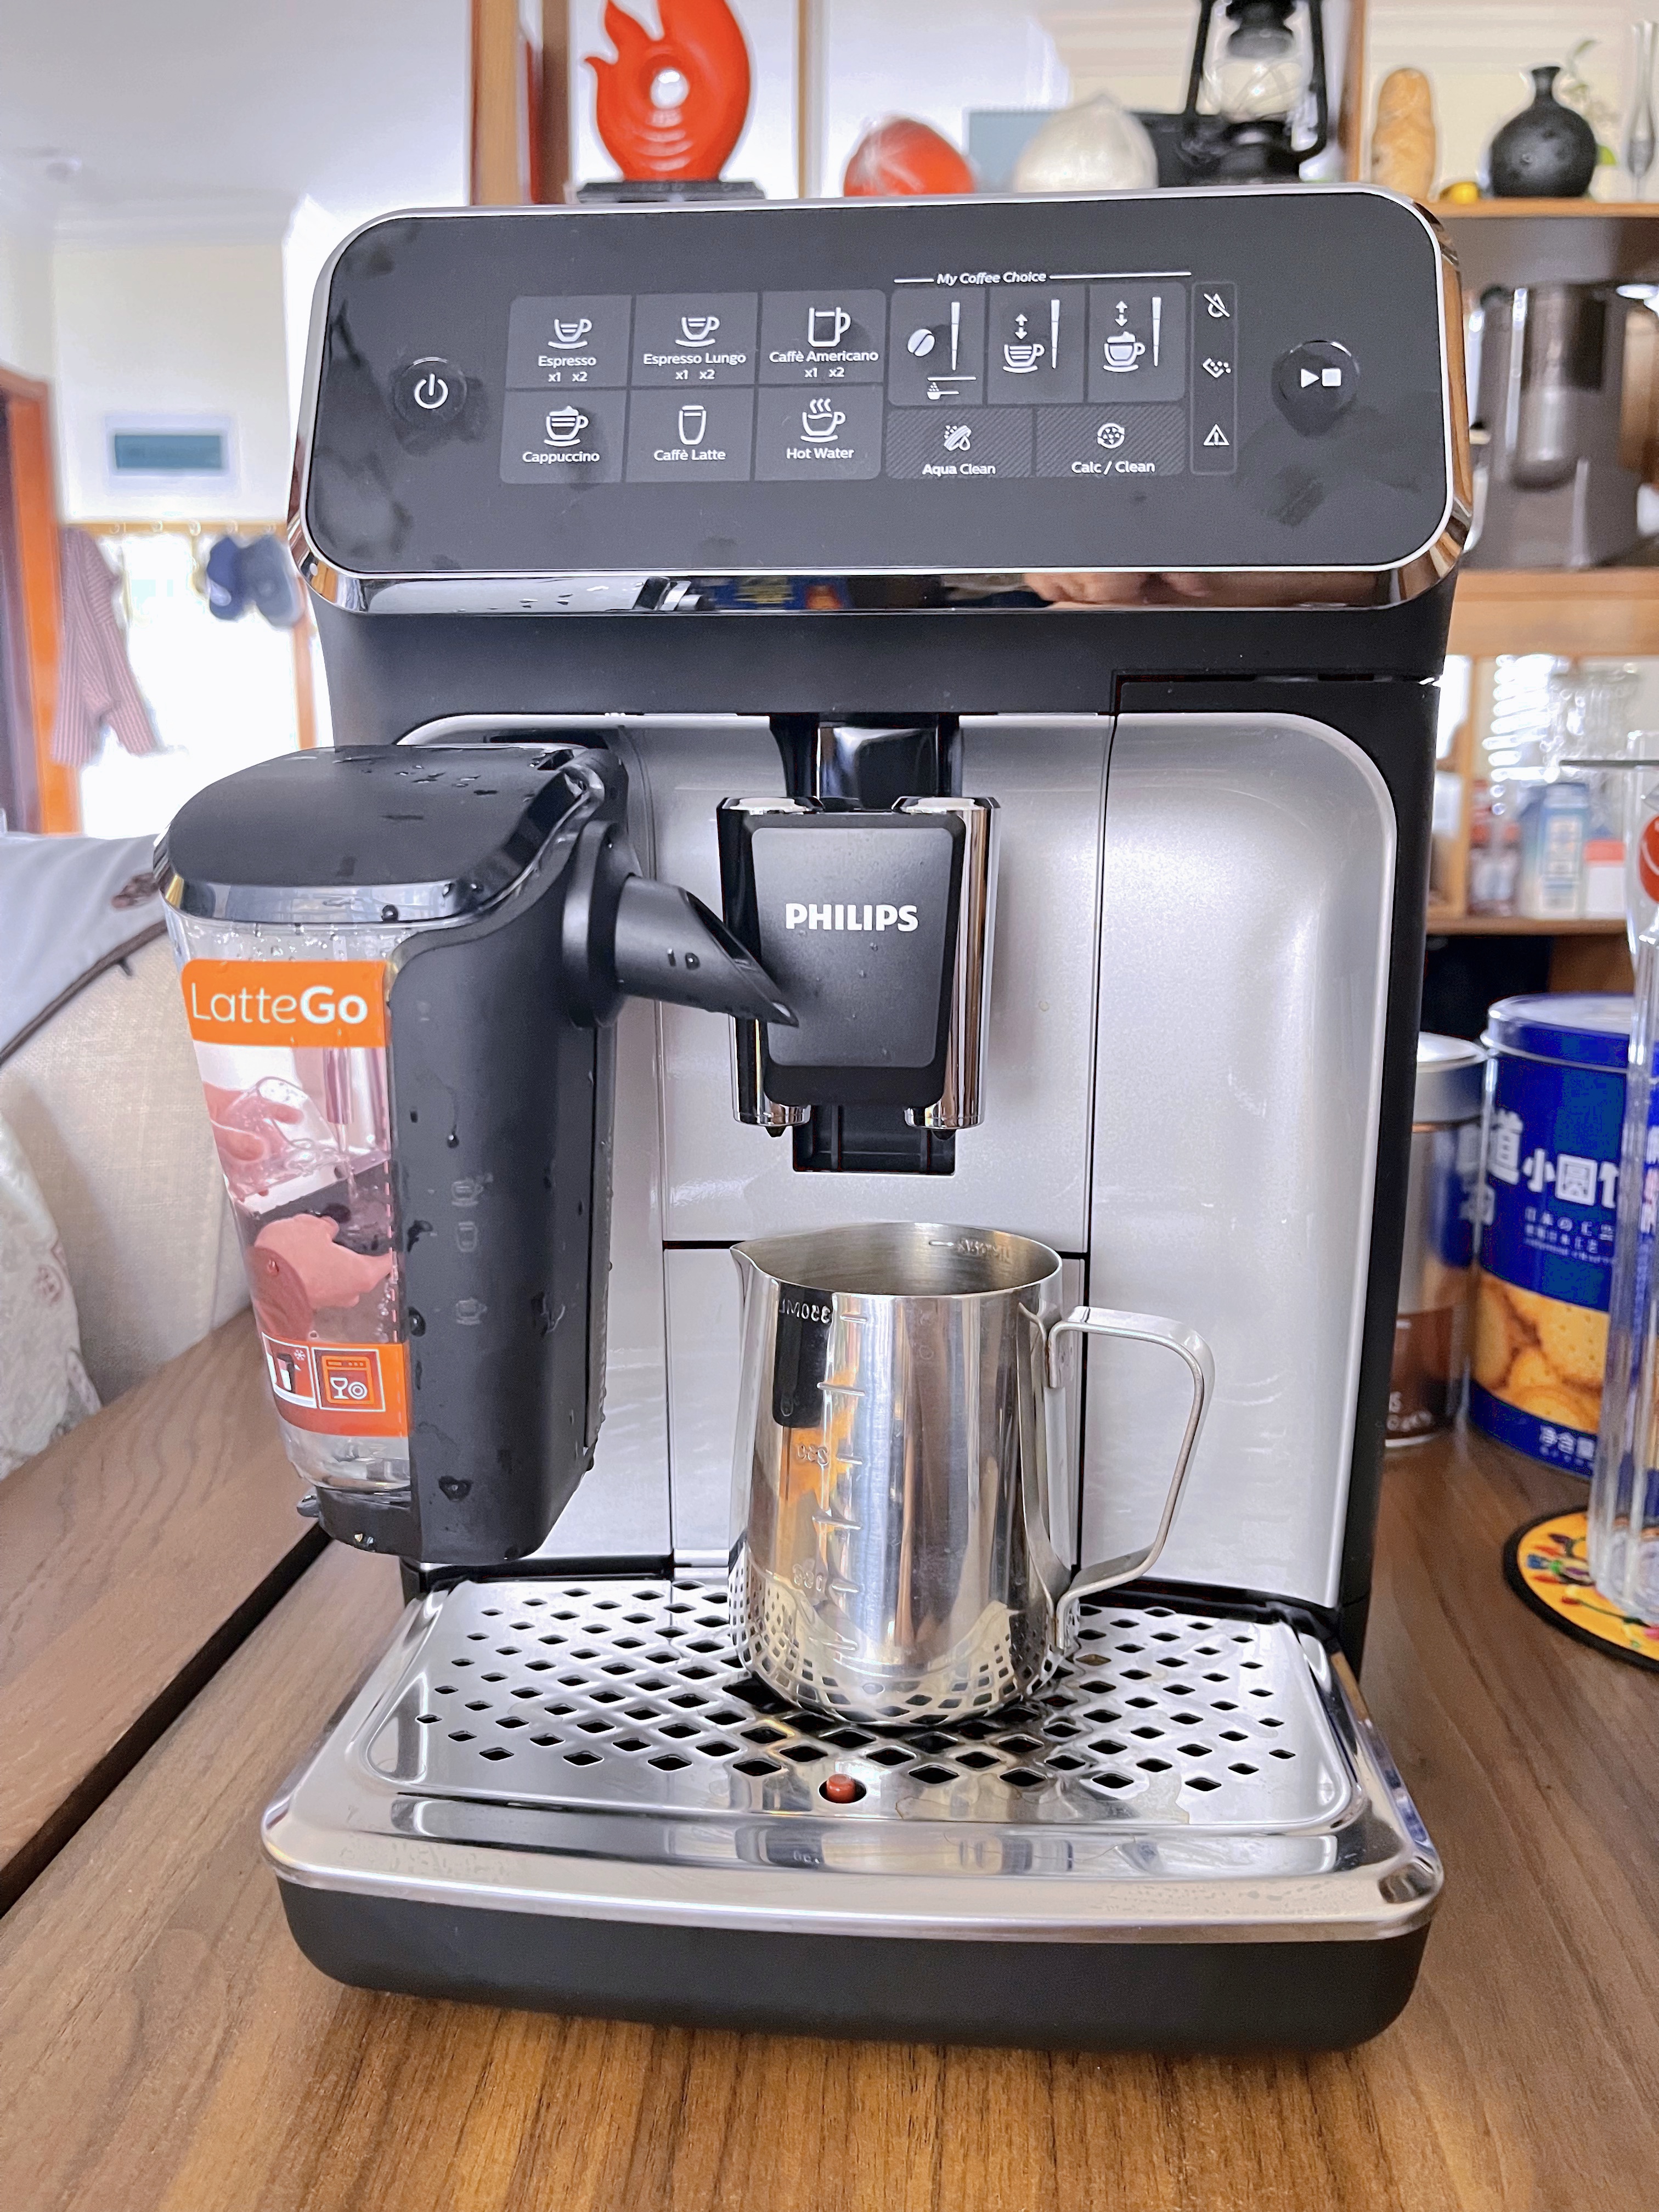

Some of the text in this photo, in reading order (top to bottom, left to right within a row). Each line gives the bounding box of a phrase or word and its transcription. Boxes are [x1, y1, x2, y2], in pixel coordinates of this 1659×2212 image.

[936, 271, 1047, 287] My Coffee Choice
[538, 356, 597, 369] Espresso
[644, 352, 747, 367] Espresso Lungo
[769, 349, 879, 363] Caffè Americano
[548, 371, 589, 383] x1 x2
[675, 369, 715, 380] x1 x2
[804, 366, 845, 379] x1 x2
[522, 450, 601, 465] Cappuccino
[653, 448, 726, 461] Caffè Latte
[786, 448, 855, 460] Hot Water
[922, 463, 997, 477] Aqua Clean
[1071, 461, 1102, 474] Calc
[1115, 460, 1156, 473] Clean
[786, 903, 919, 932] PHILIPS
[191, 982, 369, 1025] LatteGo
